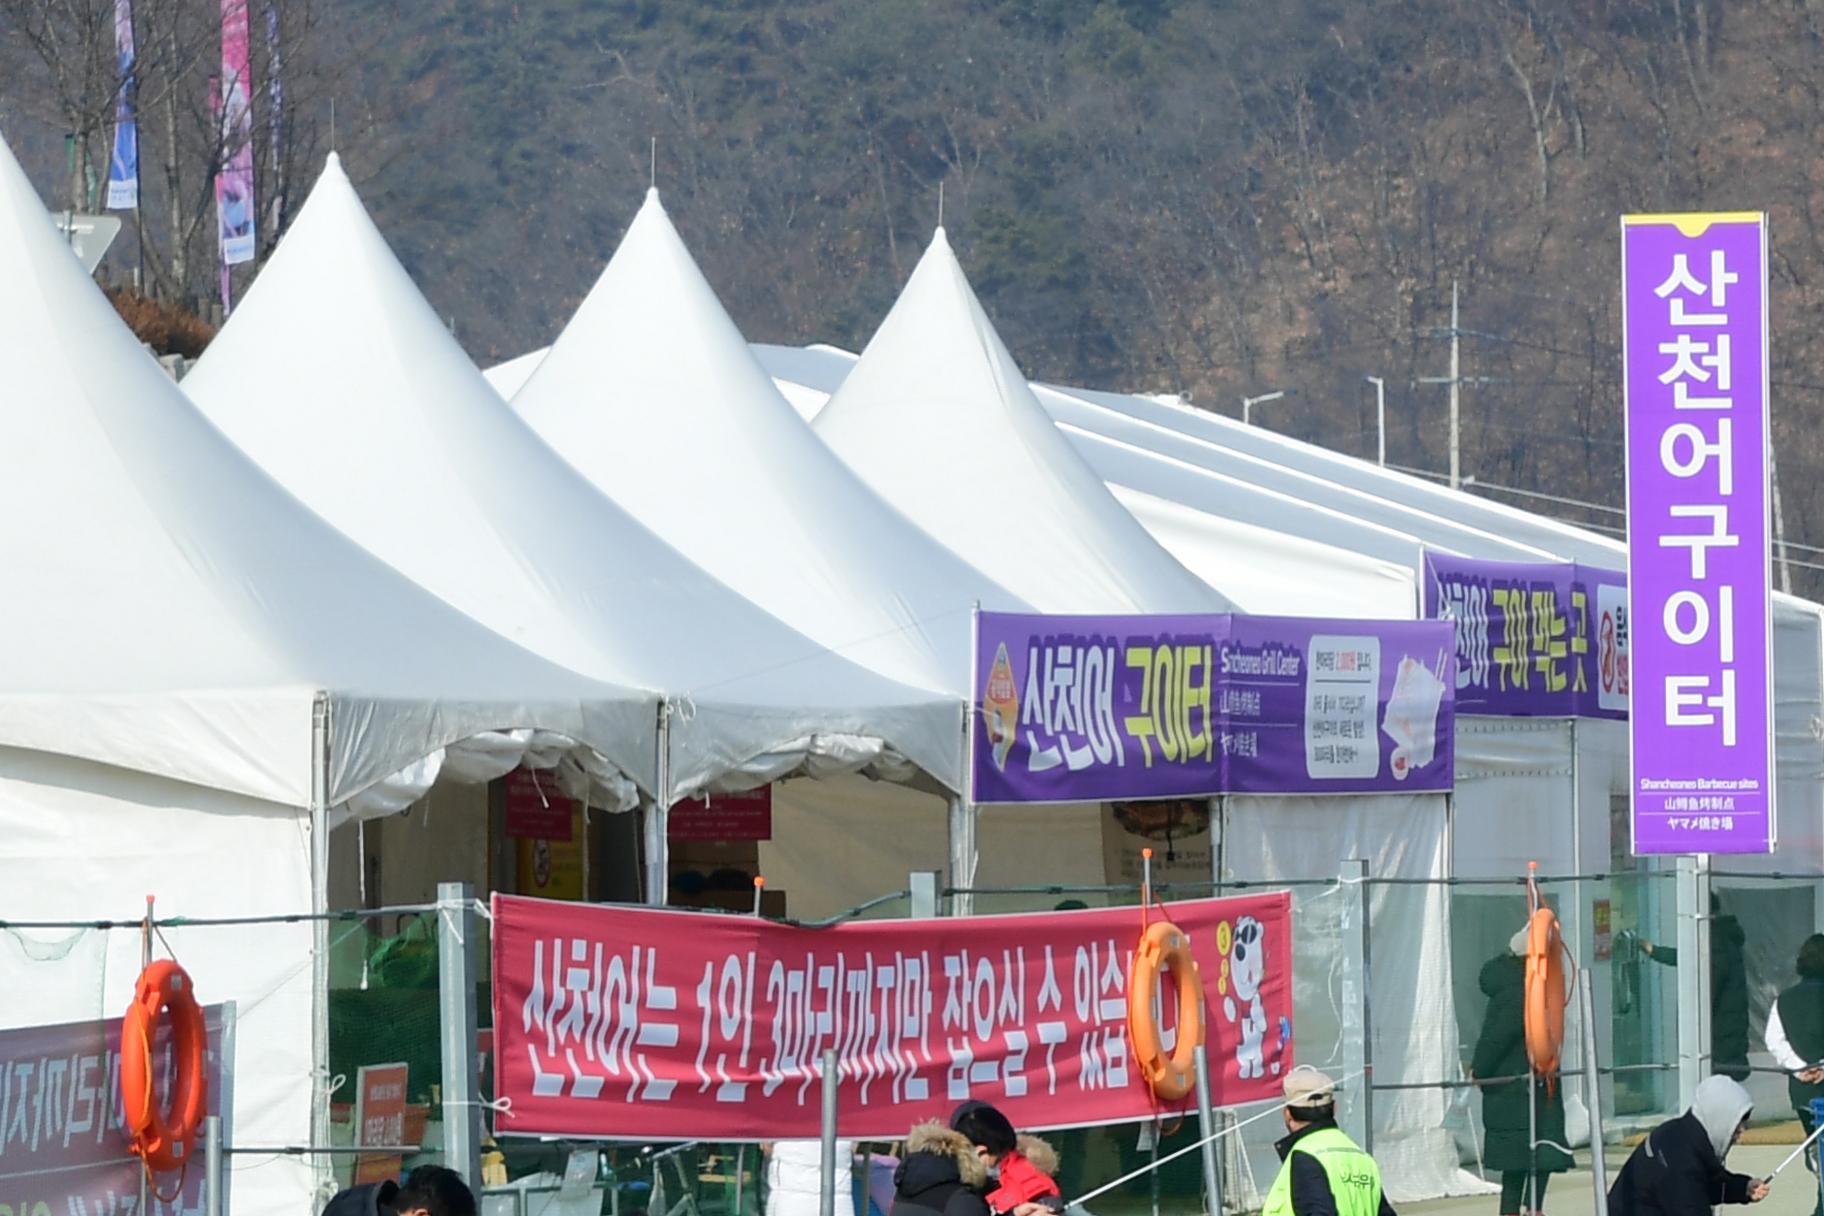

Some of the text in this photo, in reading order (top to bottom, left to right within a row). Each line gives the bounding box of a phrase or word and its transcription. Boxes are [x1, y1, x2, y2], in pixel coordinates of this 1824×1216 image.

[1654, 250, 1738, 746] 산천어구이터
[1022, 644, 1213, 772] 산천어 구이터
[1493, 588, 1529, 692] 구이
[1532, 591, 1567, 693] 먹는
[1571, 591, 1588, 692] 곳
[523, 938, 679, 1103] 산천어는
[696, 952, 756, 1103] 1인
[942, 947, 1028, 1100] 잡으실
[1036, 944, 1069, 1096] 수
